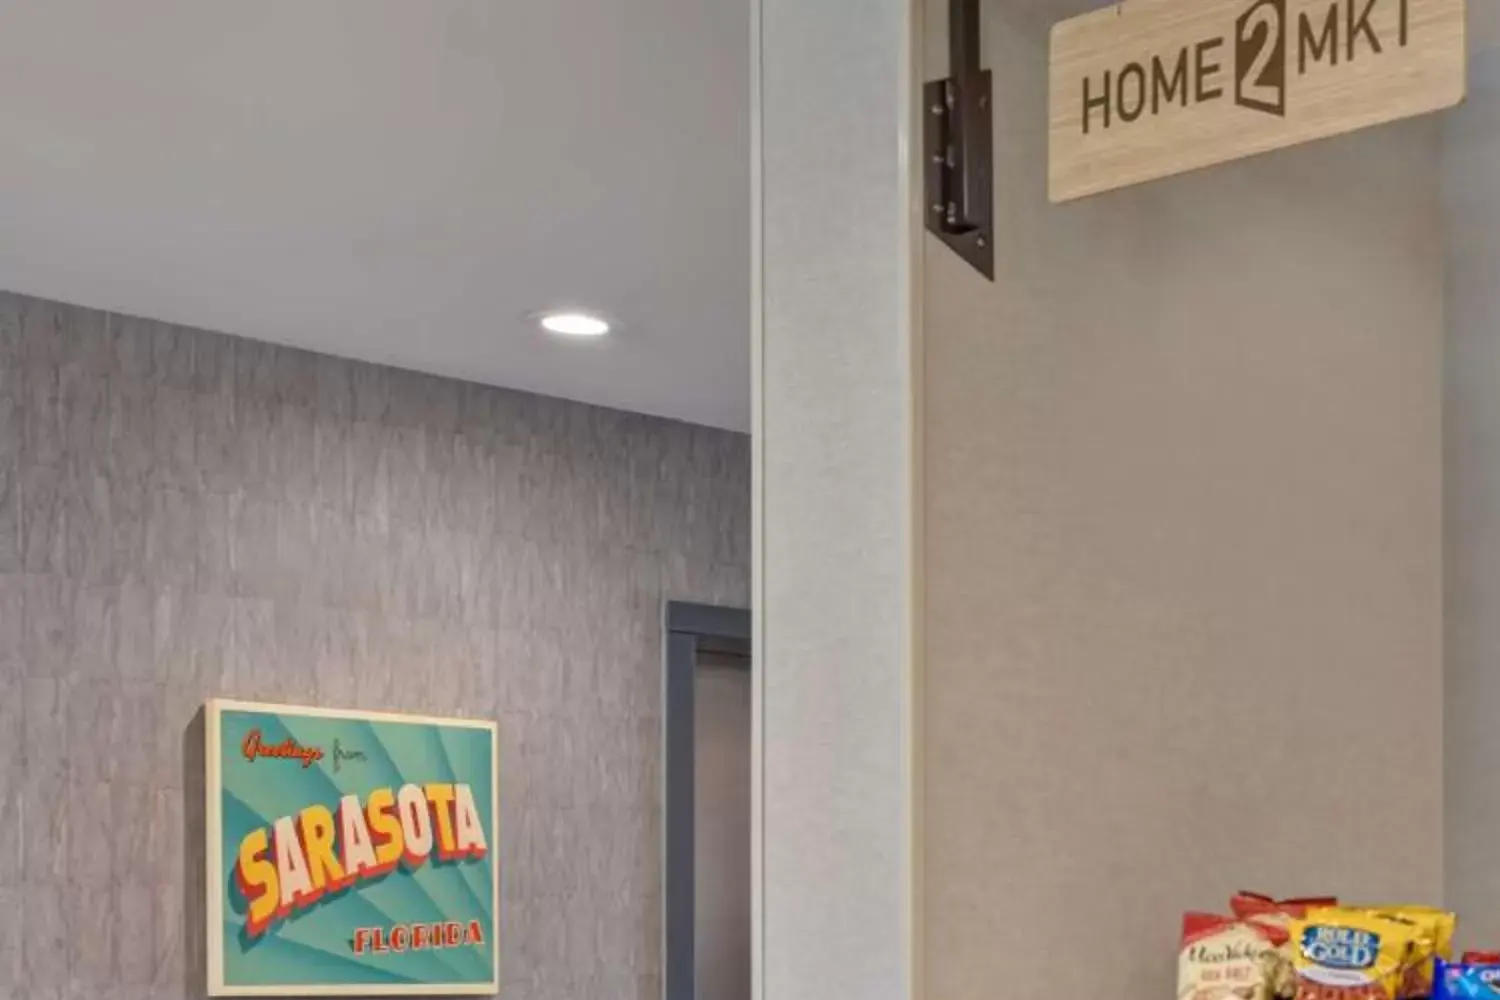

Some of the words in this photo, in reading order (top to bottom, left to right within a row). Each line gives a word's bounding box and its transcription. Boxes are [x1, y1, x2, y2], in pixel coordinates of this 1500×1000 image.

[1081, 37, 1224, 134] HOME
[236, 783, 487, 940] SARASOTA
[352, 920, 485, 956] FLORIDA
